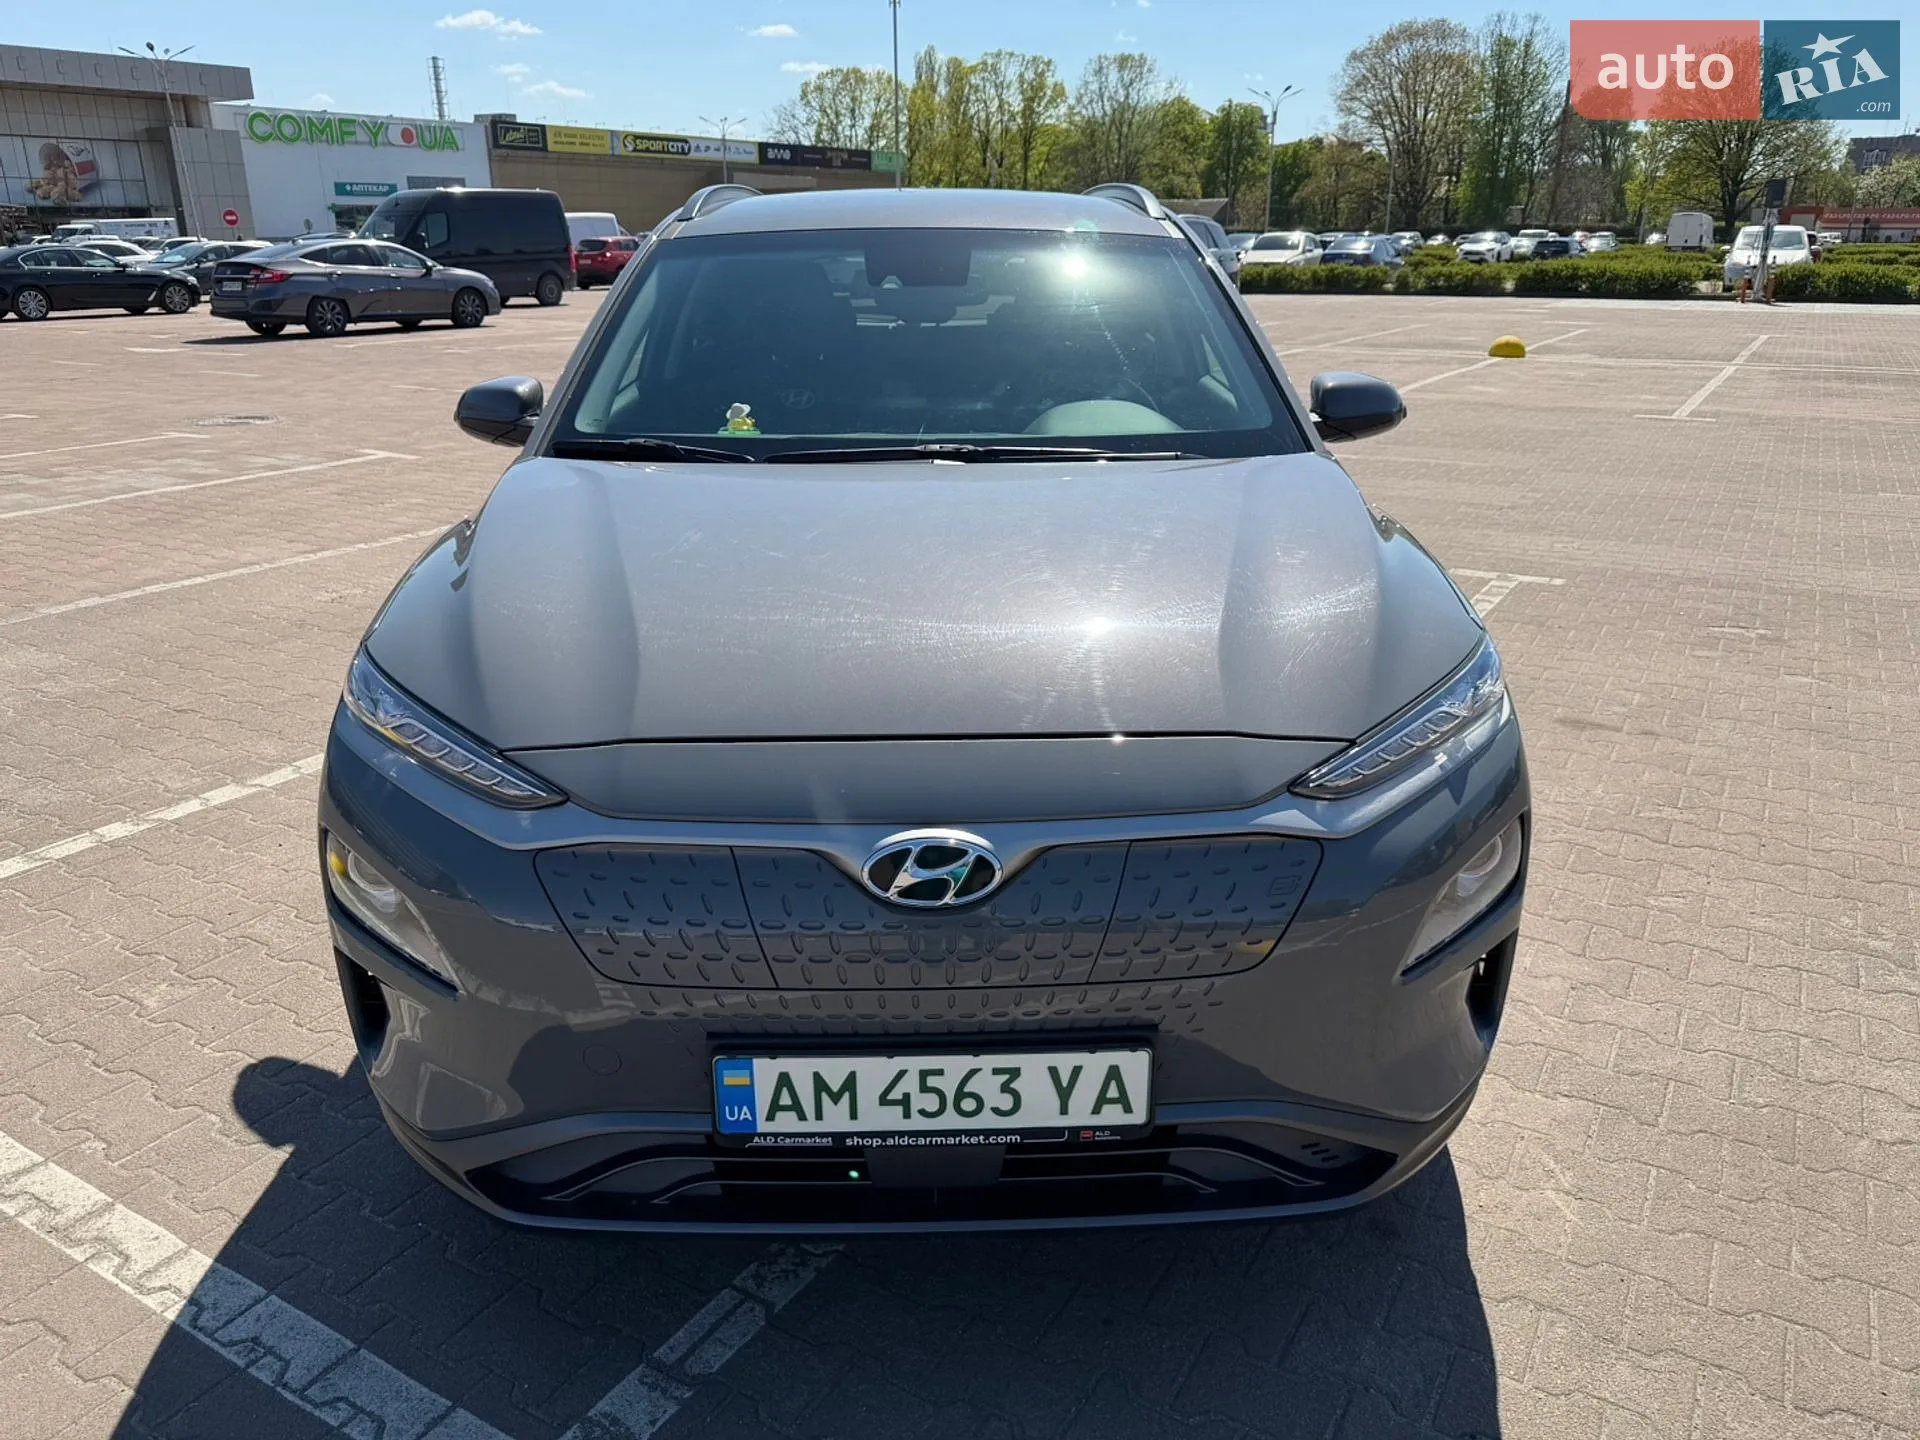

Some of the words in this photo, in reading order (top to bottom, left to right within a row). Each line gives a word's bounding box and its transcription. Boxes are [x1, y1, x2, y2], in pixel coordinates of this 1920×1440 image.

[247, 111, 385, 148] COMFY
[764, 1070, 858, 1122] AM
[878, 1067, 1022, 1120] 4563
[1047, 1064, 1134, 1116] YA
[725, 1105, 753, 1122] UA
[777, 1135, 832, 1143] Carmarket
[845, 1132, 1021, 1147] shop.aldcarmarket.com
